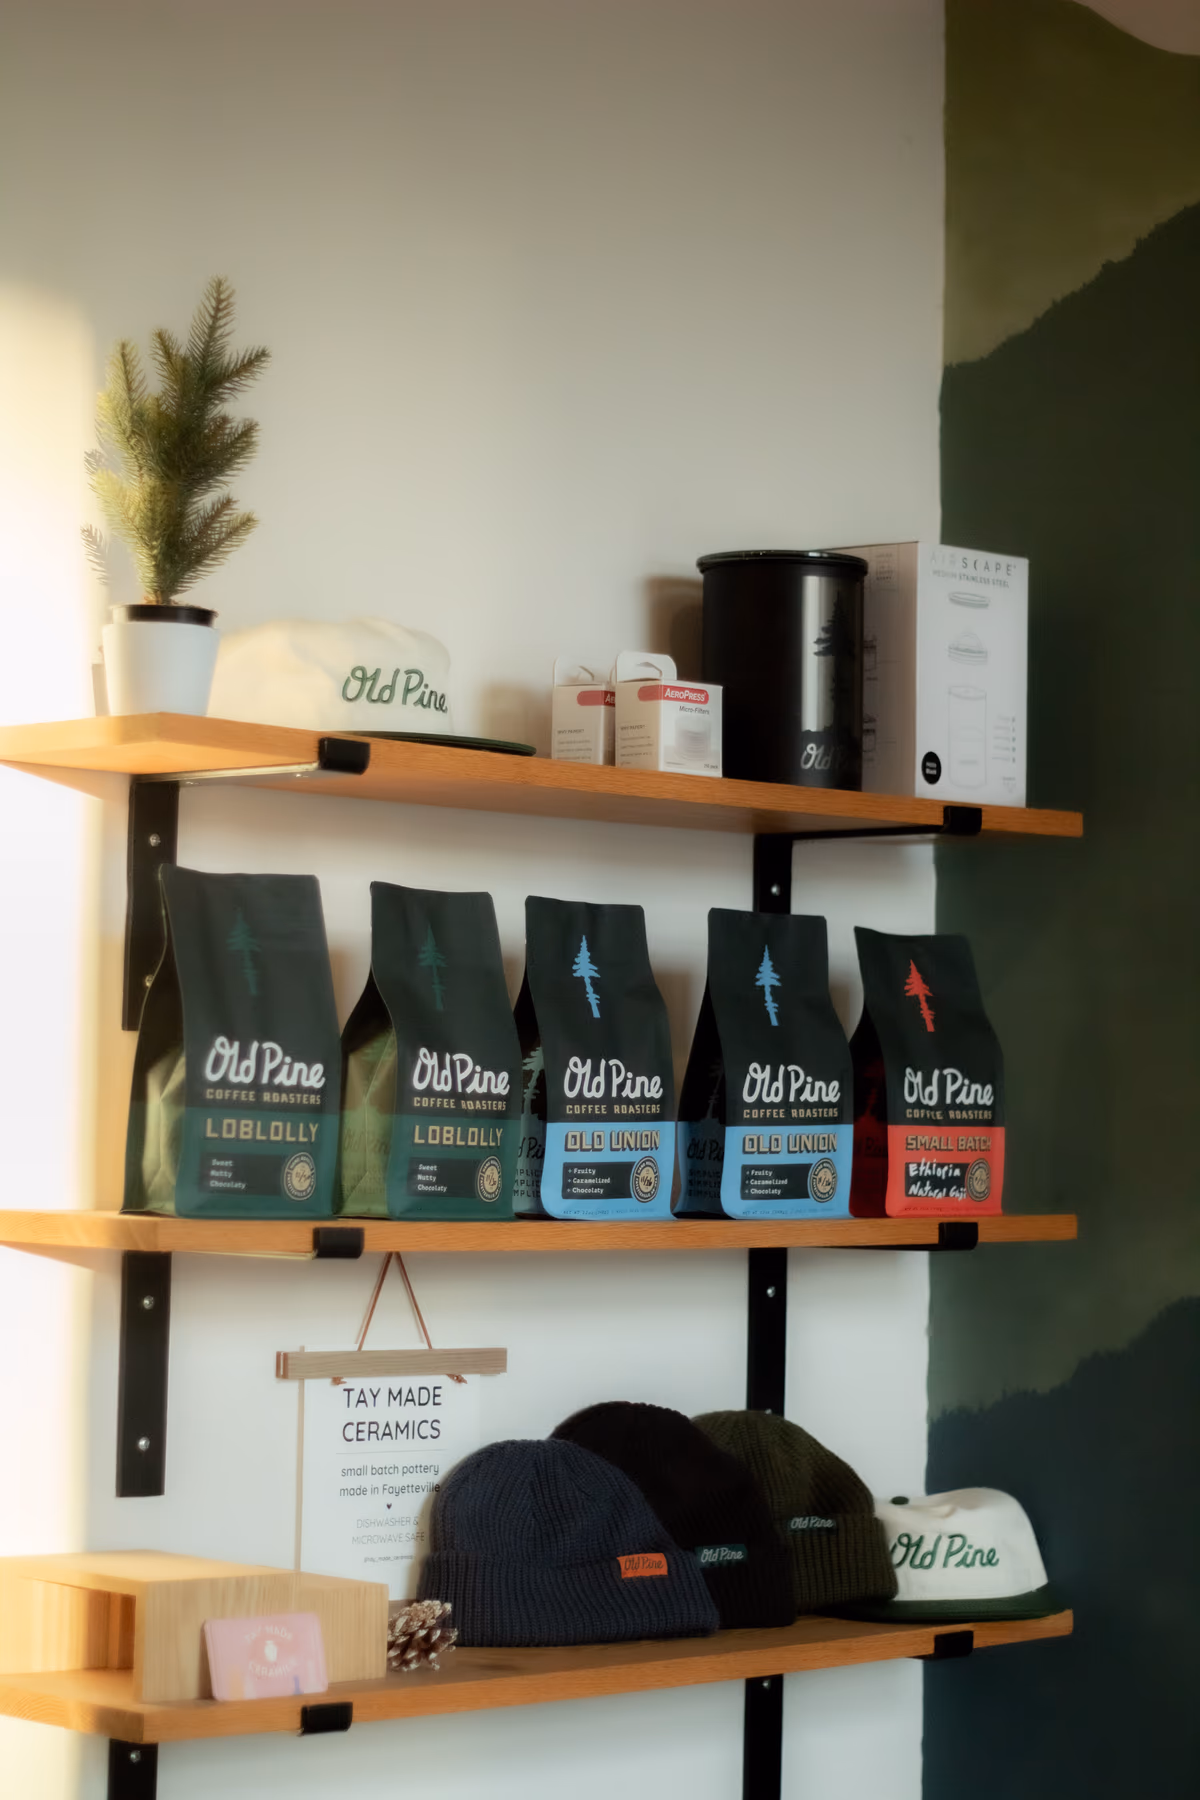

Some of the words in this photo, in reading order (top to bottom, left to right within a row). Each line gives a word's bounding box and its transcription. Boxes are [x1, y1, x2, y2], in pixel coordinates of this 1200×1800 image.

[959, 573, 990, 585] STAINLESS
[992, 578, 1010, 588] STEEL
[342, 666, 400, 704] Old
[402, 669, 448, 713] Pine
[679, 706, 710, 716] Micro-Filters
[800, 743, 833, 770] Old
[205, 1035, 259, 1084] Old
[261, 1041, 326, 1089] Pine
[413, 1047, 451, 1092] Old
[453, 1053, 510, 1096] Pine
[564, 1055, 606, 1099] Old
[608, 1058, 664, 1099] Pine
[742, 1062, 785, 1103] Old
[787, 1064, 841, 1103] Pine
[904, 1066, 940, 1106] Old
[942, 1067, 994, 1106] Pine
[206, 1088, 256, 1102] COFFEE
[263, 1091, 321, 1105] ROASTERS
[413, 1096, 456, 1109] COFFEE
[461, 1099, 506, 1111] ROASTERS
[566, 1104, 607, 1114] COFFEE
[614, 1104, 661, 1114] ROASTERS
[743, 1108, 785, 1119] COFFEE
[791, 1107, 838, 1118] ROASTERS
[906, 1108, 943, 1120] COFFEE
[949, 1109, 992, 1120] ROASTERS
[206, 1118, 319, 1143] LOBLOLLY
[414, 1124, 504, 1147] LOBLOLLY
[564, 1130, 605, 1152] OLD
[609, 1129, 660, 1152] UNION
[742, 1133, 782, 1155] OLD
[787, 1132, 838, 1154] UNION
[906, 1135, 954, 1152] SMALL
[957, 1136, 991, 1152] BATCH
[211, 1158, 234, 1167] Sweet
[418, 1163, 438, 1172] Sweet
[908, 1157, 961, 1180] Ethiopia
[209, 1169, 233, 1179] Nutty
[417, 1173, 437, 1183] Nutty
[573, 1167, 596, 1176] Fruity
[750, 1169, 773, 1177] Fruity
[209, 1179, 247, 1190] Chocolaty
[416, 1183, 448, 1193] Chocolaty
[749, 1178, 788, 1186] Caramelized
[572, 1186, 605, 1195] Chocolaty
[750, 1187, 782, 1196] Chocolaty
[908, 1180, 947, 1200] Natural
[342, 1387, 381, 1409] TAY
[387, 1385, 442, 1407] MADE
[342, 1419, 441, 1442] CERAMICS
[341, 1464, 367, 1477] small
[370, 1464, 400, 1476] batch
[402, 1463, 440, 1477] pottery
[339, 1485, 368, 1497] made
[370, 1484, 379, 1496] in
[382, 1481, 441, 1497] Fayetteville
[356, 1516, 411, 1529] DISHWASHER
[791, 1516, 809, 1528] Old
[809, 1516, 834, 1528] Pine
[352, 1532, 403, 1545] MICROWAVE
[405, 1531, 425, 1543] SAFE
[701, 1548, 718, 1563] Old
[719, 1547, 744, 1560] Pine
[890, 1533, 942, 1569] Old
[943, 1533, 999, 1569] Pine
[624, 1556, 640, 1571] Old
[641, 1556, 664, 1569] Pine
